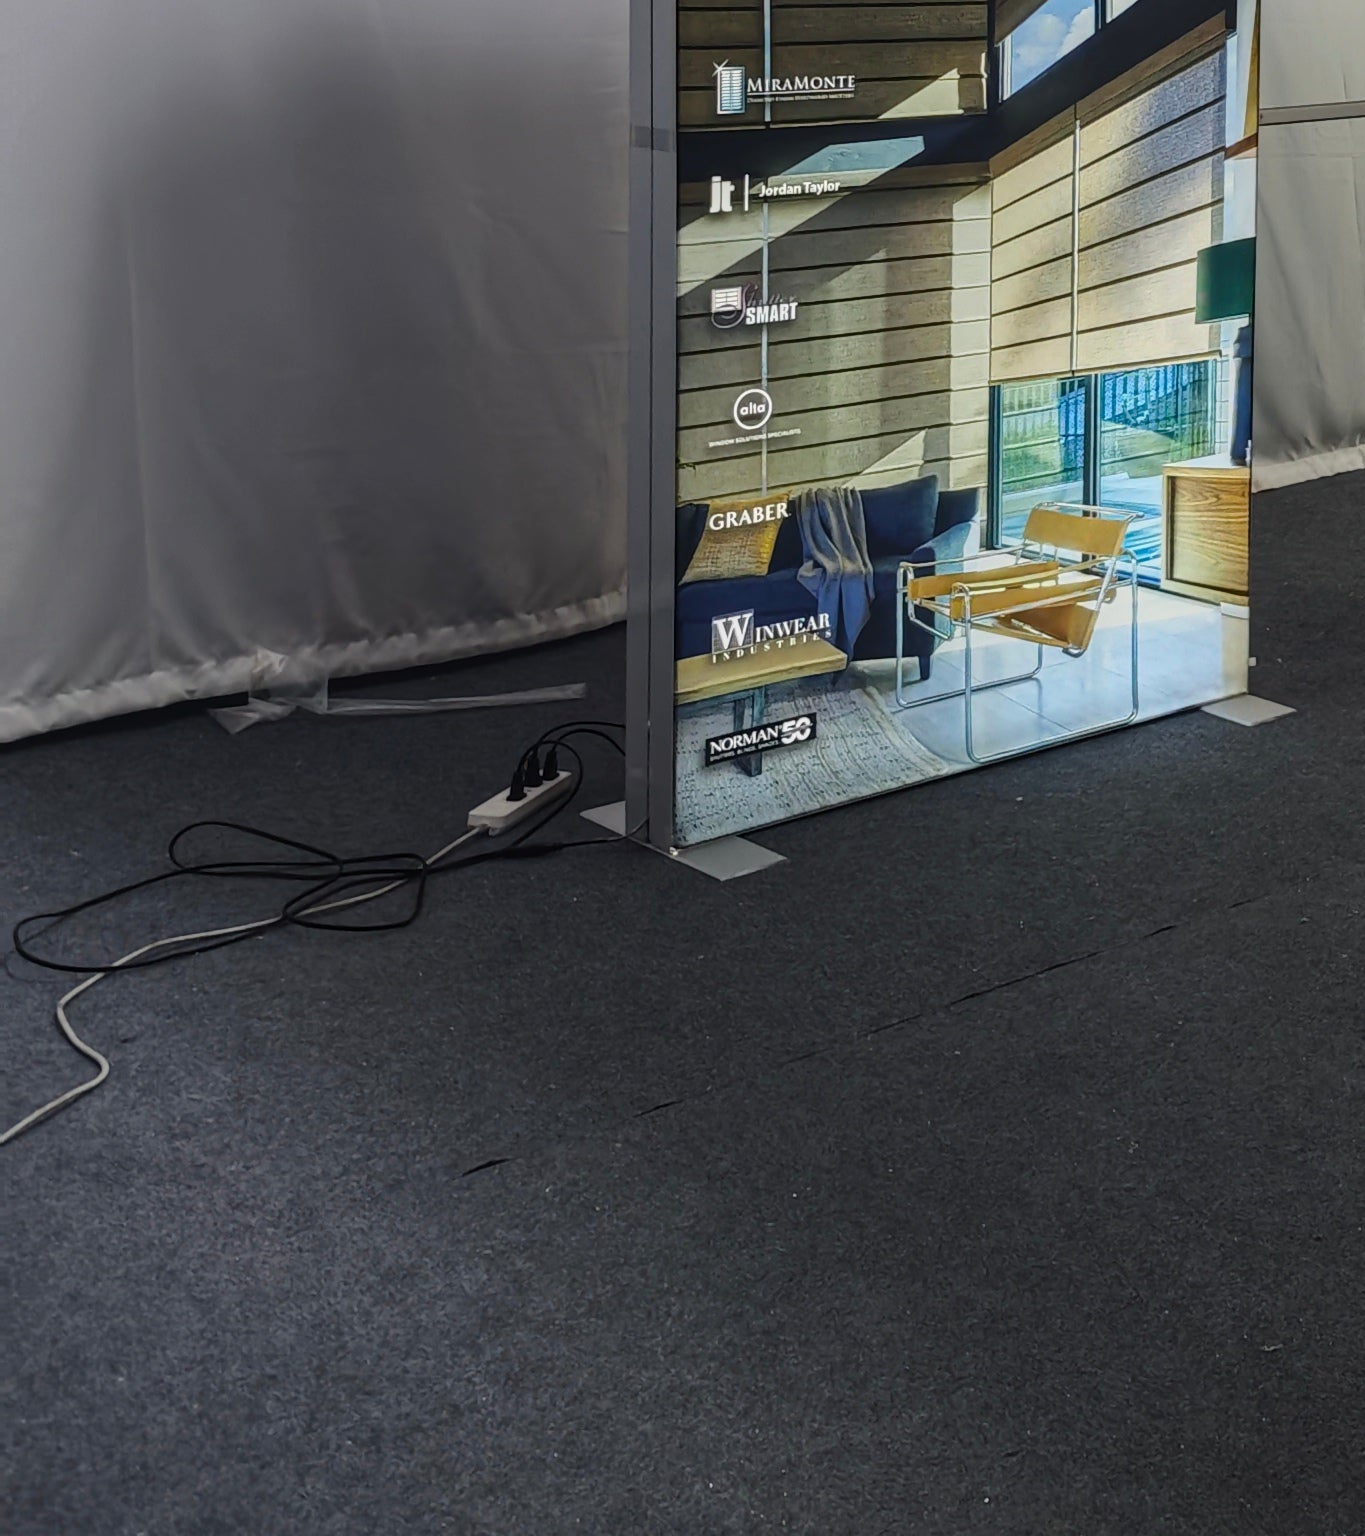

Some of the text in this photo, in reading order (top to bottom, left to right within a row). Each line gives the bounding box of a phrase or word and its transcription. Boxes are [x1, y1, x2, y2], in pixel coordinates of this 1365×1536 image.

[759, 181, 841, 197] Jordan Taylor
[745, 302, 798, 325] SMART
[740, 402, 766, 415] alta
[708, 502, 788, 531] GRABER
[712, 629, 832, 664] INDUSTRIES
[781, 716, 813, 744] 50
